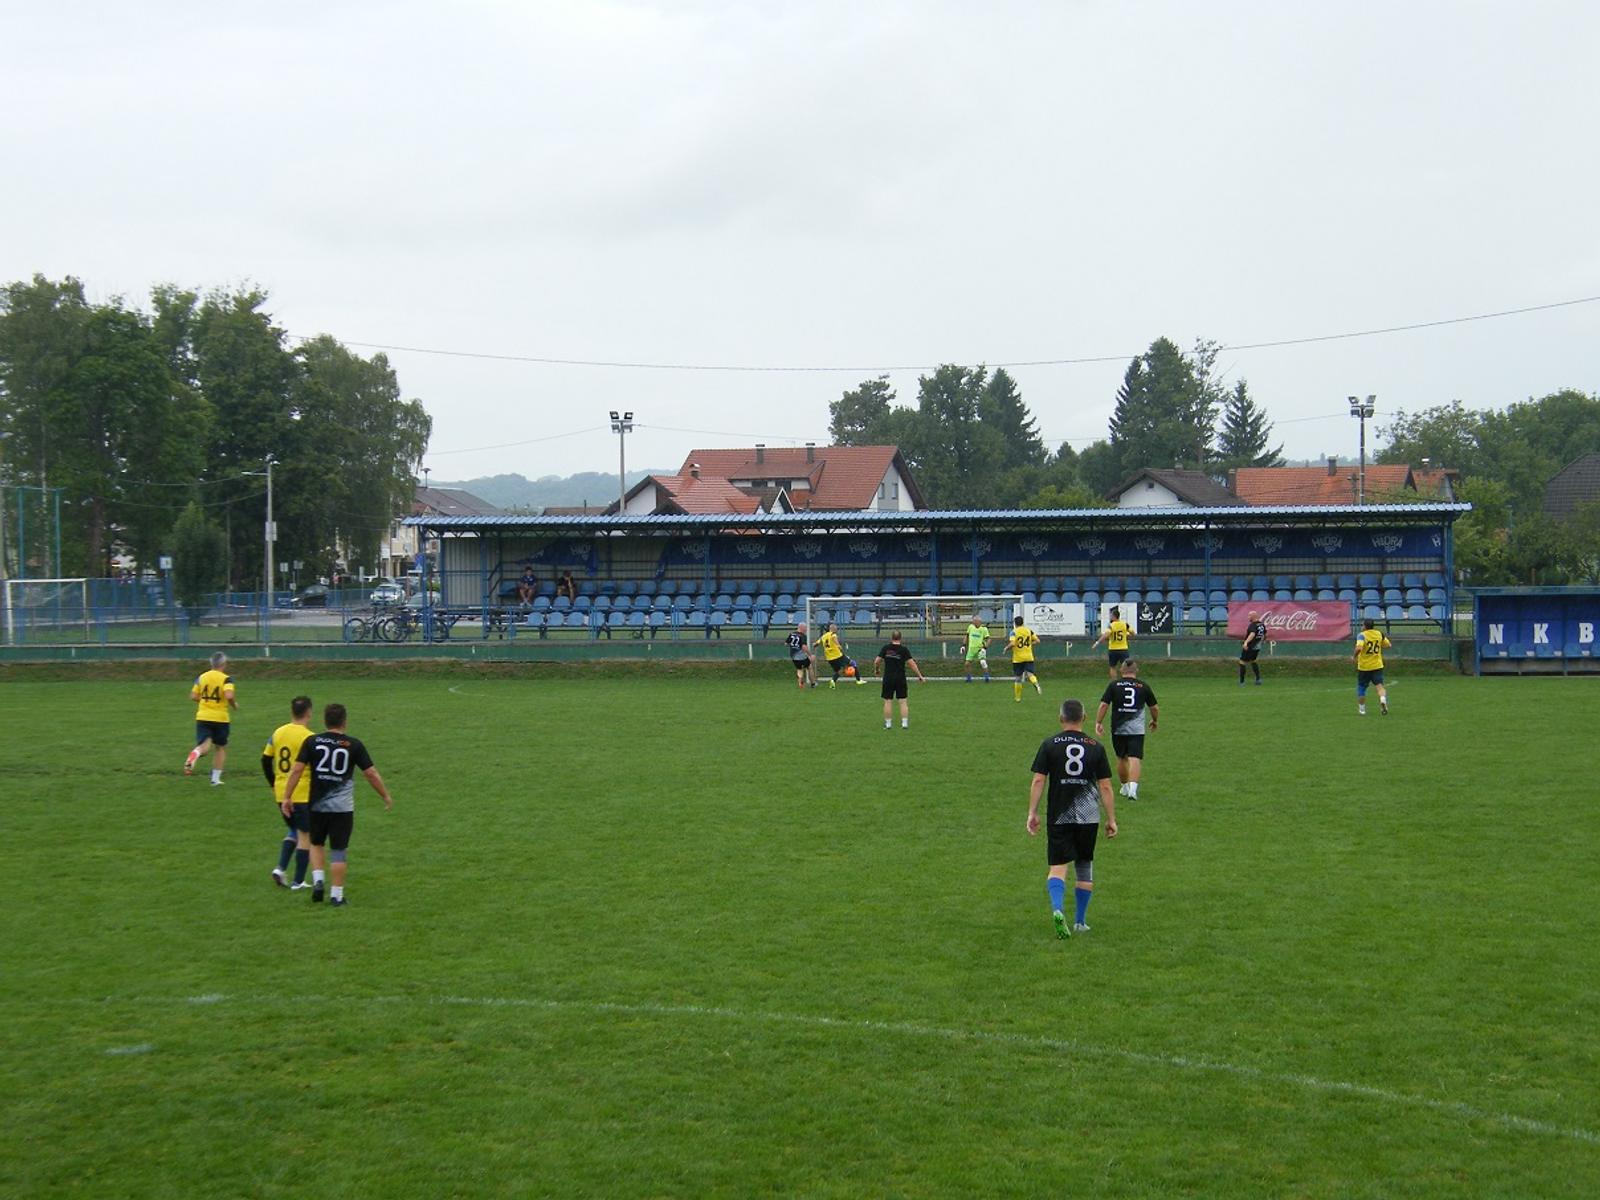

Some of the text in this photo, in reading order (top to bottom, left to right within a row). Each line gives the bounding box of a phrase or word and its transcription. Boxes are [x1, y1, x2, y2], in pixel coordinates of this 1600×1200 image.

[790, 635, 800, 647] 22
[1017, 636, 1030, 649] 34
[1113, 630, 1123, 642] 15
[1488, 622, 1595, 644] N K B
[1366, 640, 1380, 654] 26
[201, 684, 222, 703] 44
[1123, 687, 1136, 707] 3
[1054, 736, 1097, 746] DUPLICO
[278, 746, 291, 773] 8
[315, 744, 349, 775] 20
[1064, 743, 1085, 776] 8
